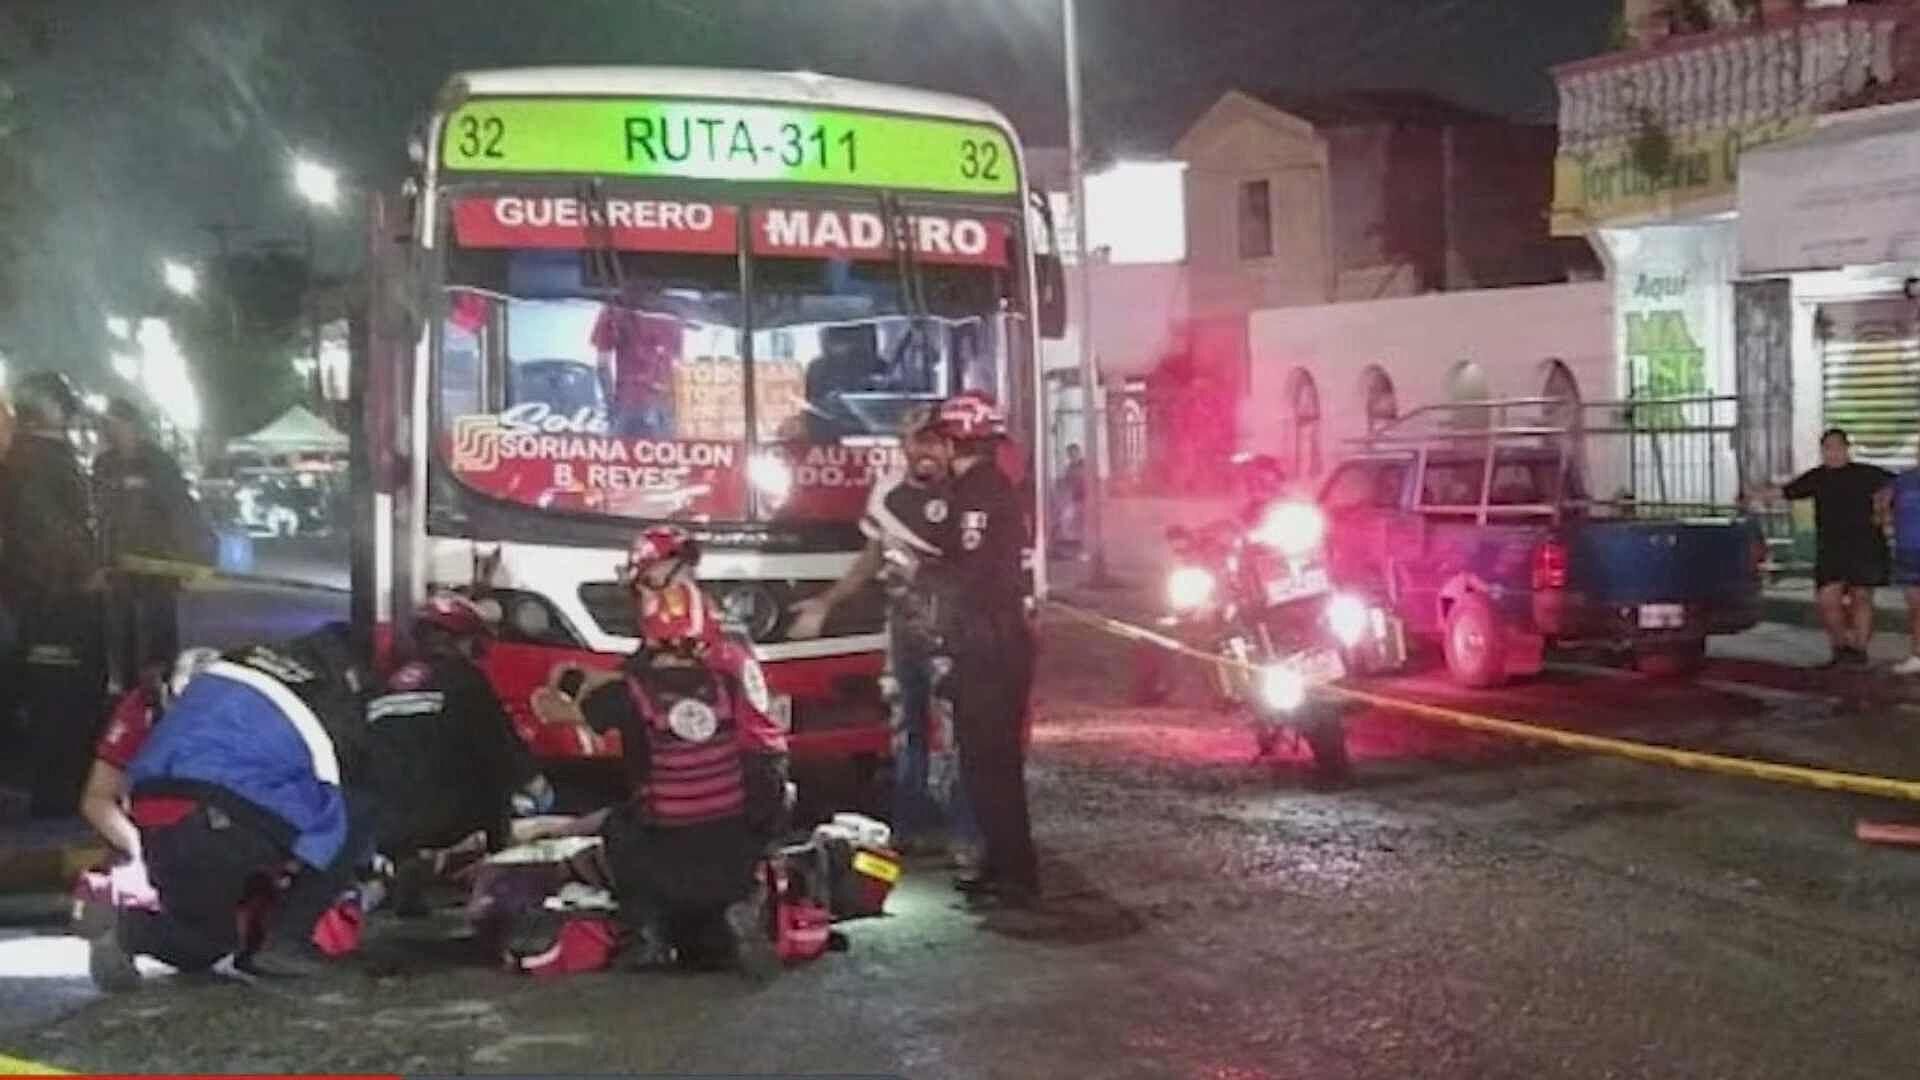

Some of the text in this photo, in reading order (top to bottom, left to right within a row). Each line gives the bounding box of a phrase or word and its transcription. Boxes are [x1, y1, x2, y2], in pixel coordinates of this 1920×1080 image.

[459, 115, 504, 157] 32
[624, 116, 858, 173] RUTA-311
[960, 139, 999, 181] 32
[500, 434, 734, 468] SORIANA COLON
[587, 465, 684, 490] REYES
